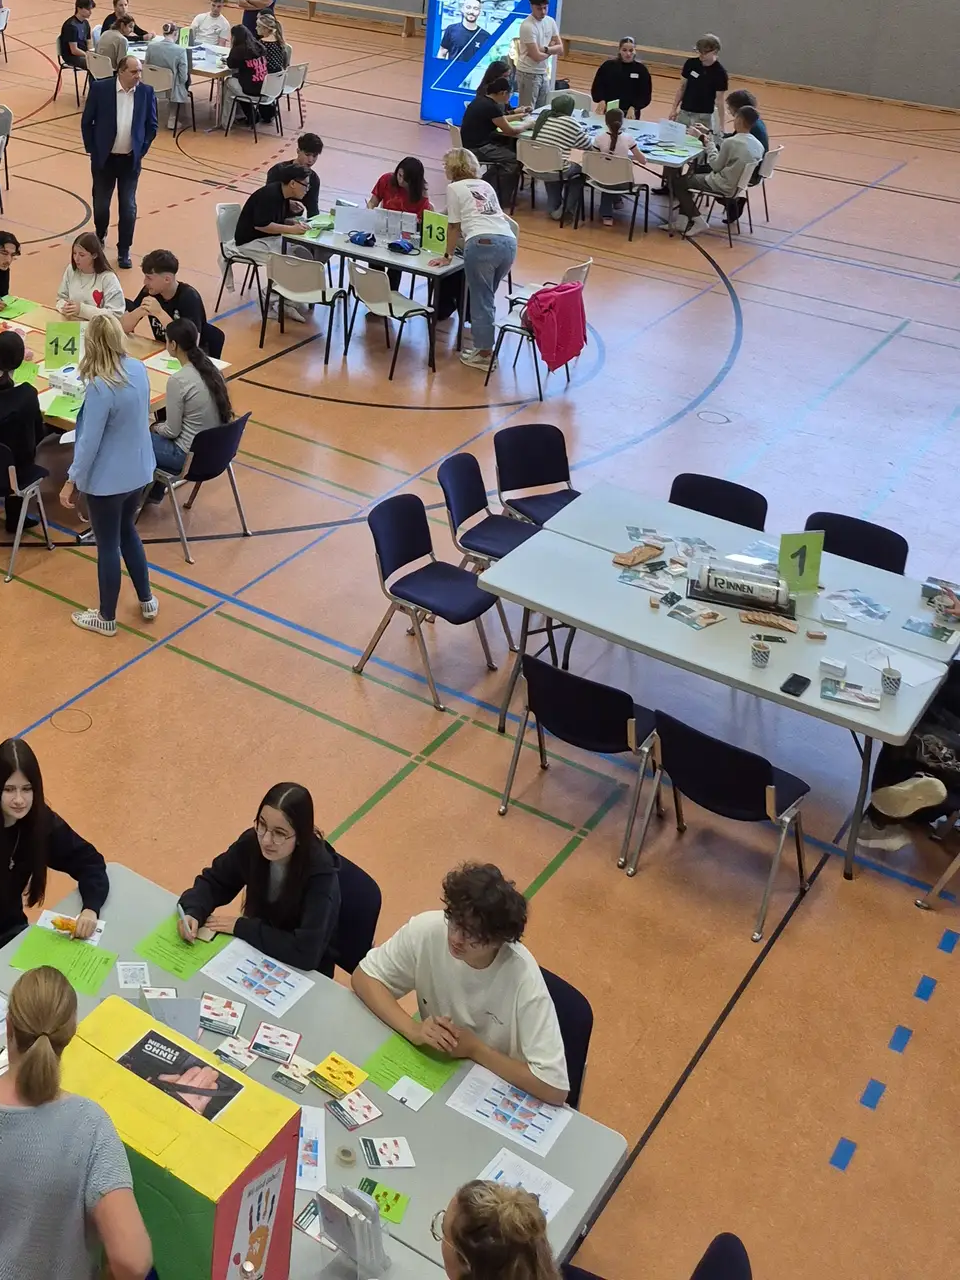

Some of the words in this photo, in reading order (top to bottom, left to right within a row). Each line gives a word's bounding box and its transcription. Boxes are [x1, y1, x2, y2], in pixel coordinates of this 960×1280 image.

[425, 224, 446, 242] 13
[49, 336, 77, 356] 14
[790, 544, 807, 577] 1
[714, 577, 754, 594] RINNEN
[147, 1038, 181, 1057] NIEMALS
